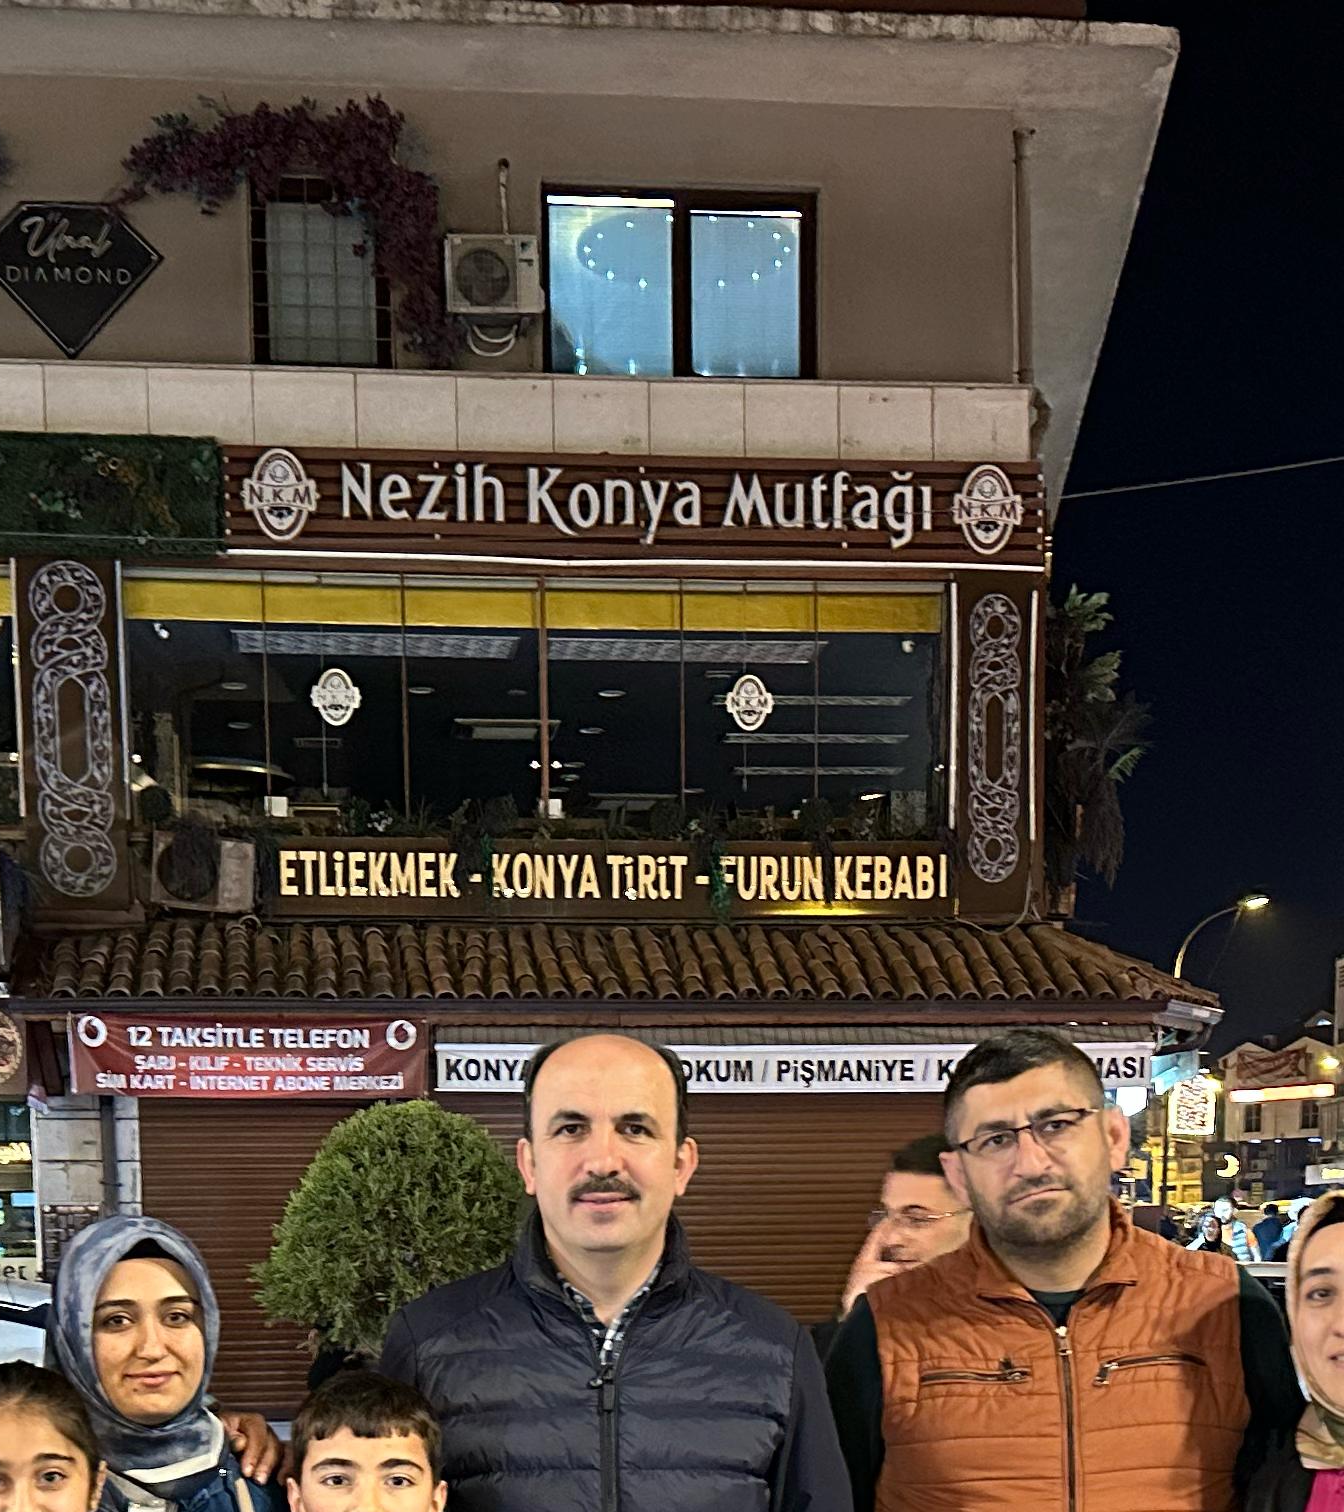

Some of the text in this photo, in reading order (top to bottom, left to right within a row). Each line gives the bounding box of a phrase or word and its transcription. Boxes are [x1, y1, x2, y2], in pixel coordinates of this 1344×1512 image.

[6, 265, 133, 286] DIAMOND
[341, 461, 932, 550] Nezih Konya Mutfağı
[492, 853, 600, 899] KONYA
[834, 855, 948, 899] KEBABI
[127, 1023, 370, 1049] 12 TAKSİTLE TELEFON
[189, 1056, 230, 1071] KILIF
[244, 1054, 302, 1072] TEKNİK
[306, 1055, 364, 1072] SERVİS
[130, 1073, 176, 1089] KART
[189, 1071, 270, 1090] İNTERNET
[273, 1075, 331, 1091] ABONE
[334, 1072, 404, 1090] MERKEZİ
